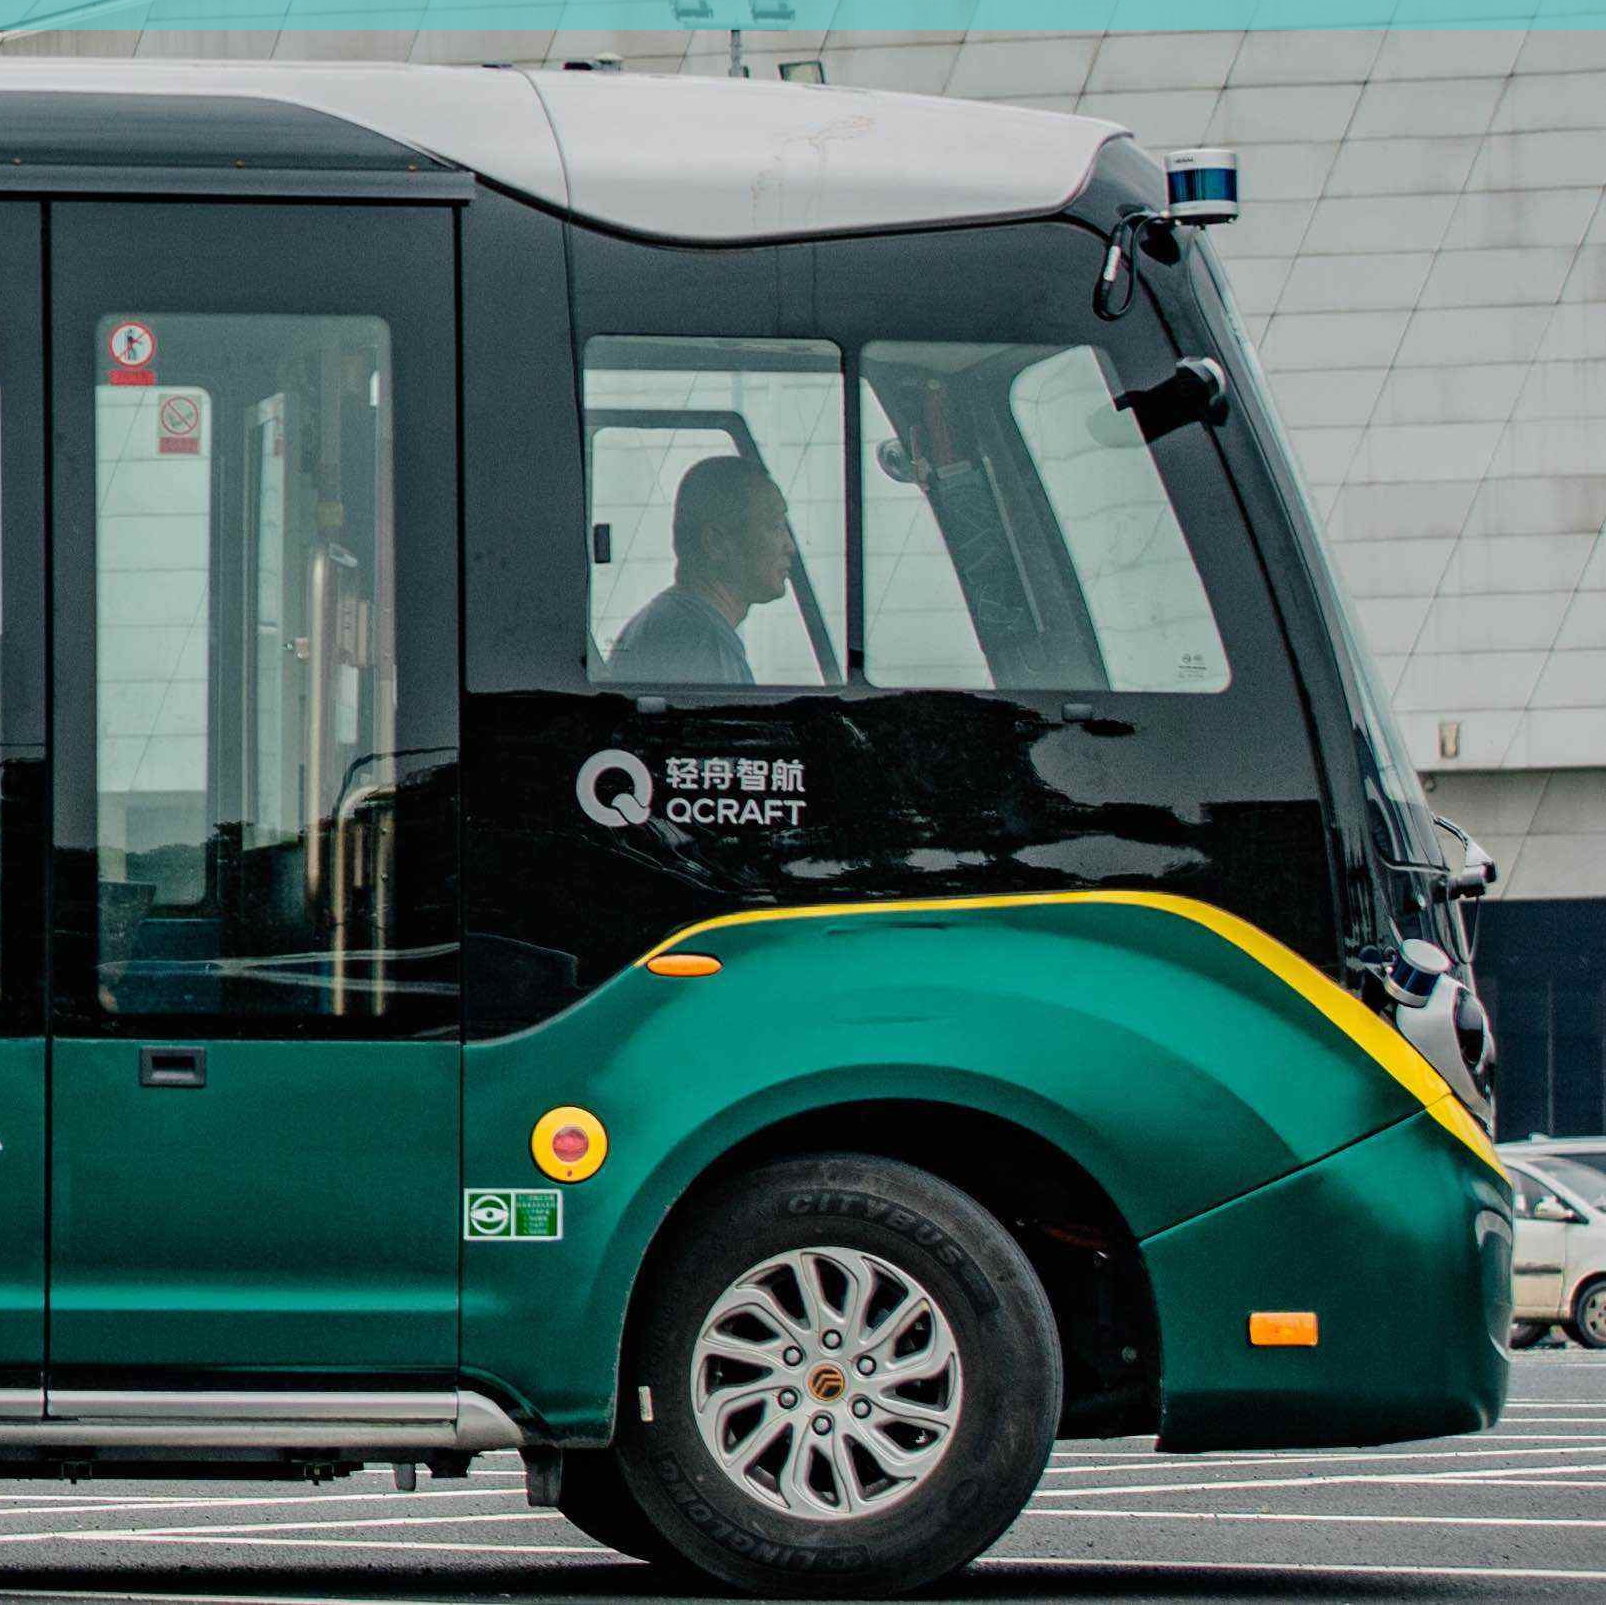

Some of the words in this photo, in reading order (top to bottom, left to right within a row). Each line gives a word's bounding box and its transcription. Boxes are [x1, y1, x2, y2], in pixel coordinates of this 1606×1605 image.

[665, 757, 806, 792] 轻舟智航
[665, 797, 807, 826] QCRAFT
[786, 1191, 967, 1268] CITYBUS
